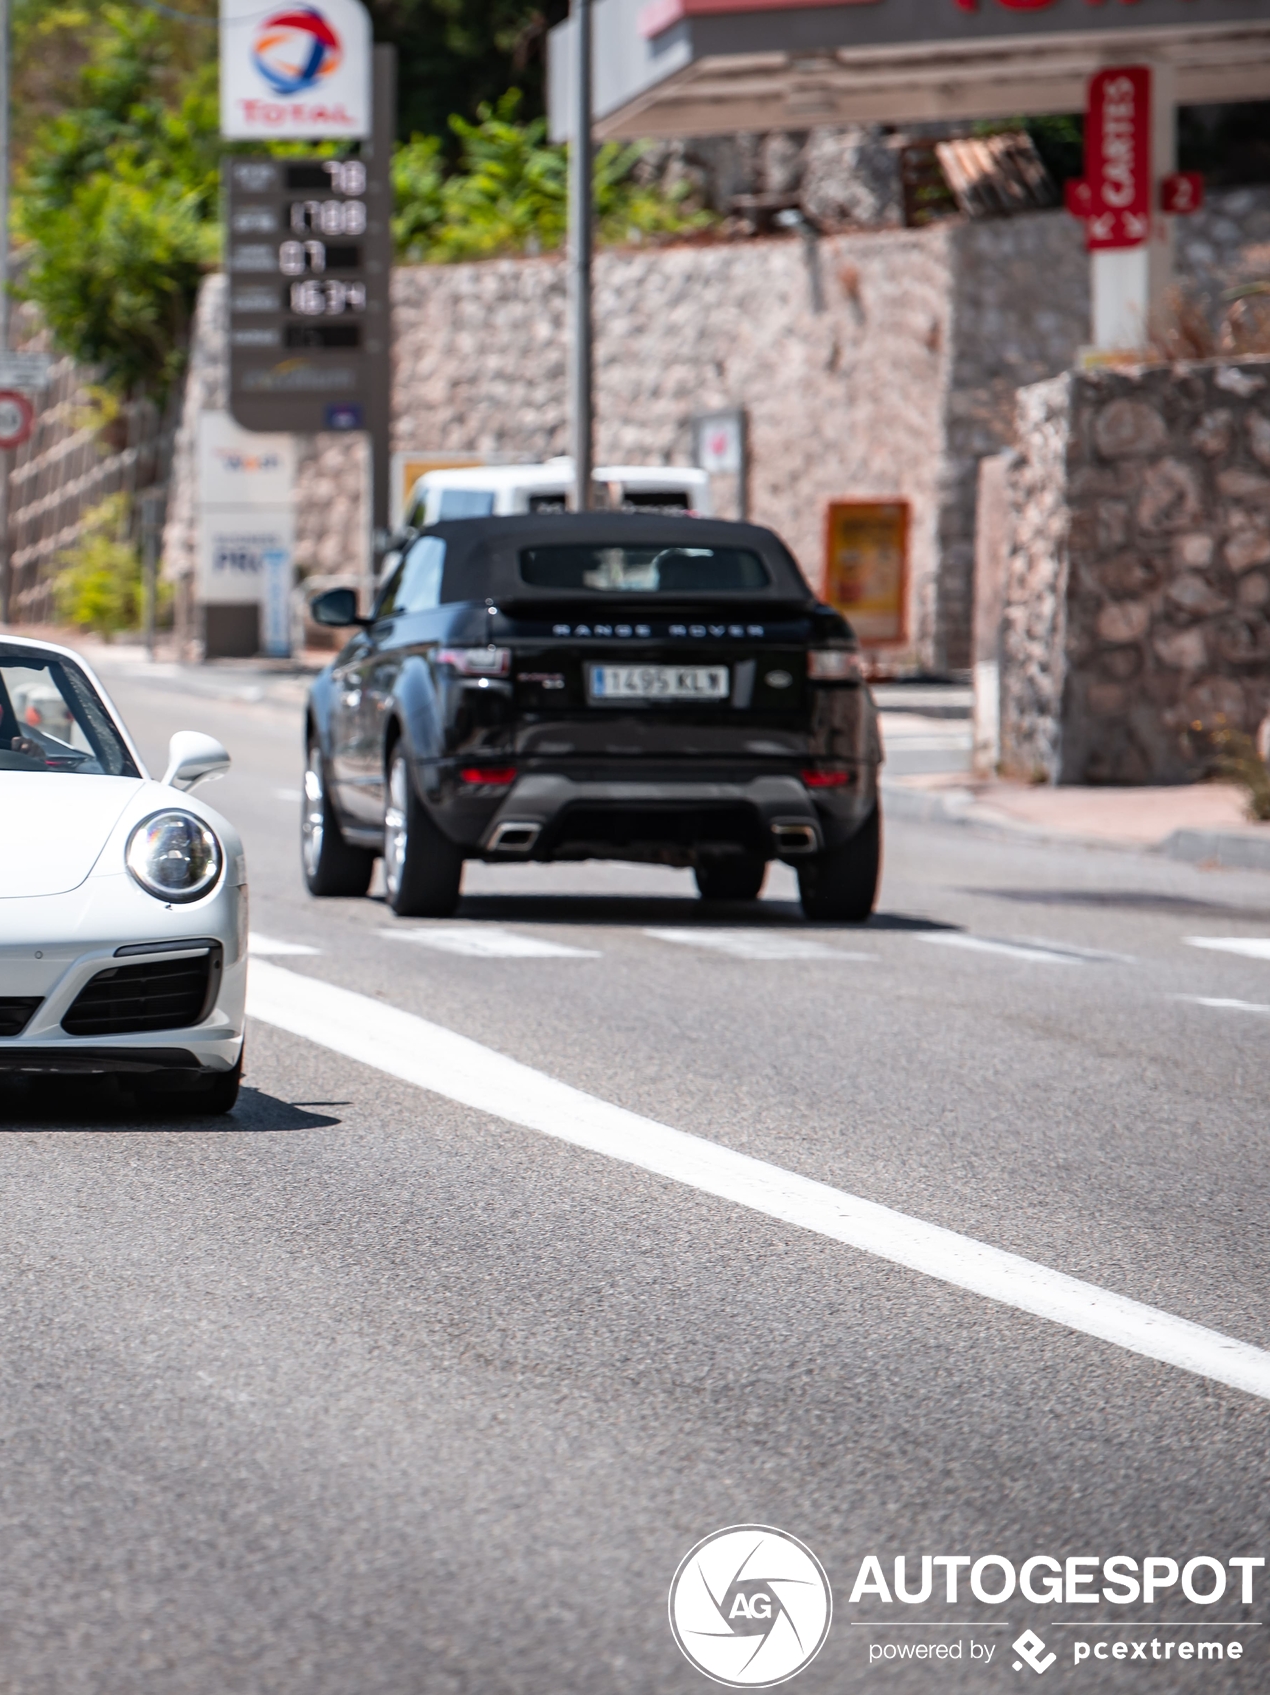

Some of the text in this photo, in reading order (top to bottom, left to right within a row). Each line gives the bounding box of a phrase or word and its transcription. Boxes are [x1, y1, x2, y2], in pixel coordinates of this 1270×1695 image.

[240, 99, 356, 127] TOTAL
[552, 624, 765, 637] RANGE ROVER
